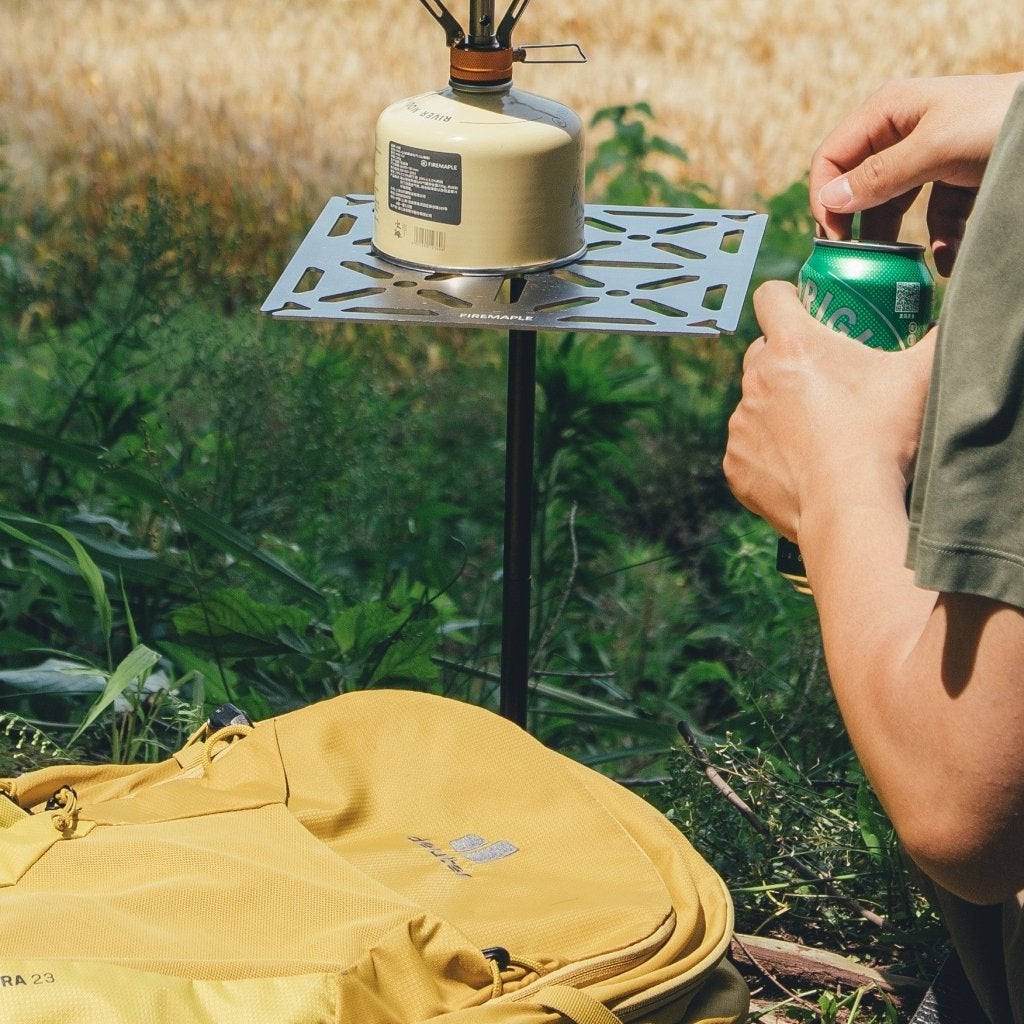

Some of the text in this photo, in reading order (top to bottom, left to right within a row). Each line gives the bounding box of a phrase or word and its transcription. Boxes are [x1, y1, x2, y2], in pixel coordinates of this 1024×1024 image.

[419, 110, 453, 123] RIVER
[427, 161, 458, 171] FIREMAPLE
[459, 313, 533, 321] FIREMAPLE
[31, 972, 55, 985] 23
